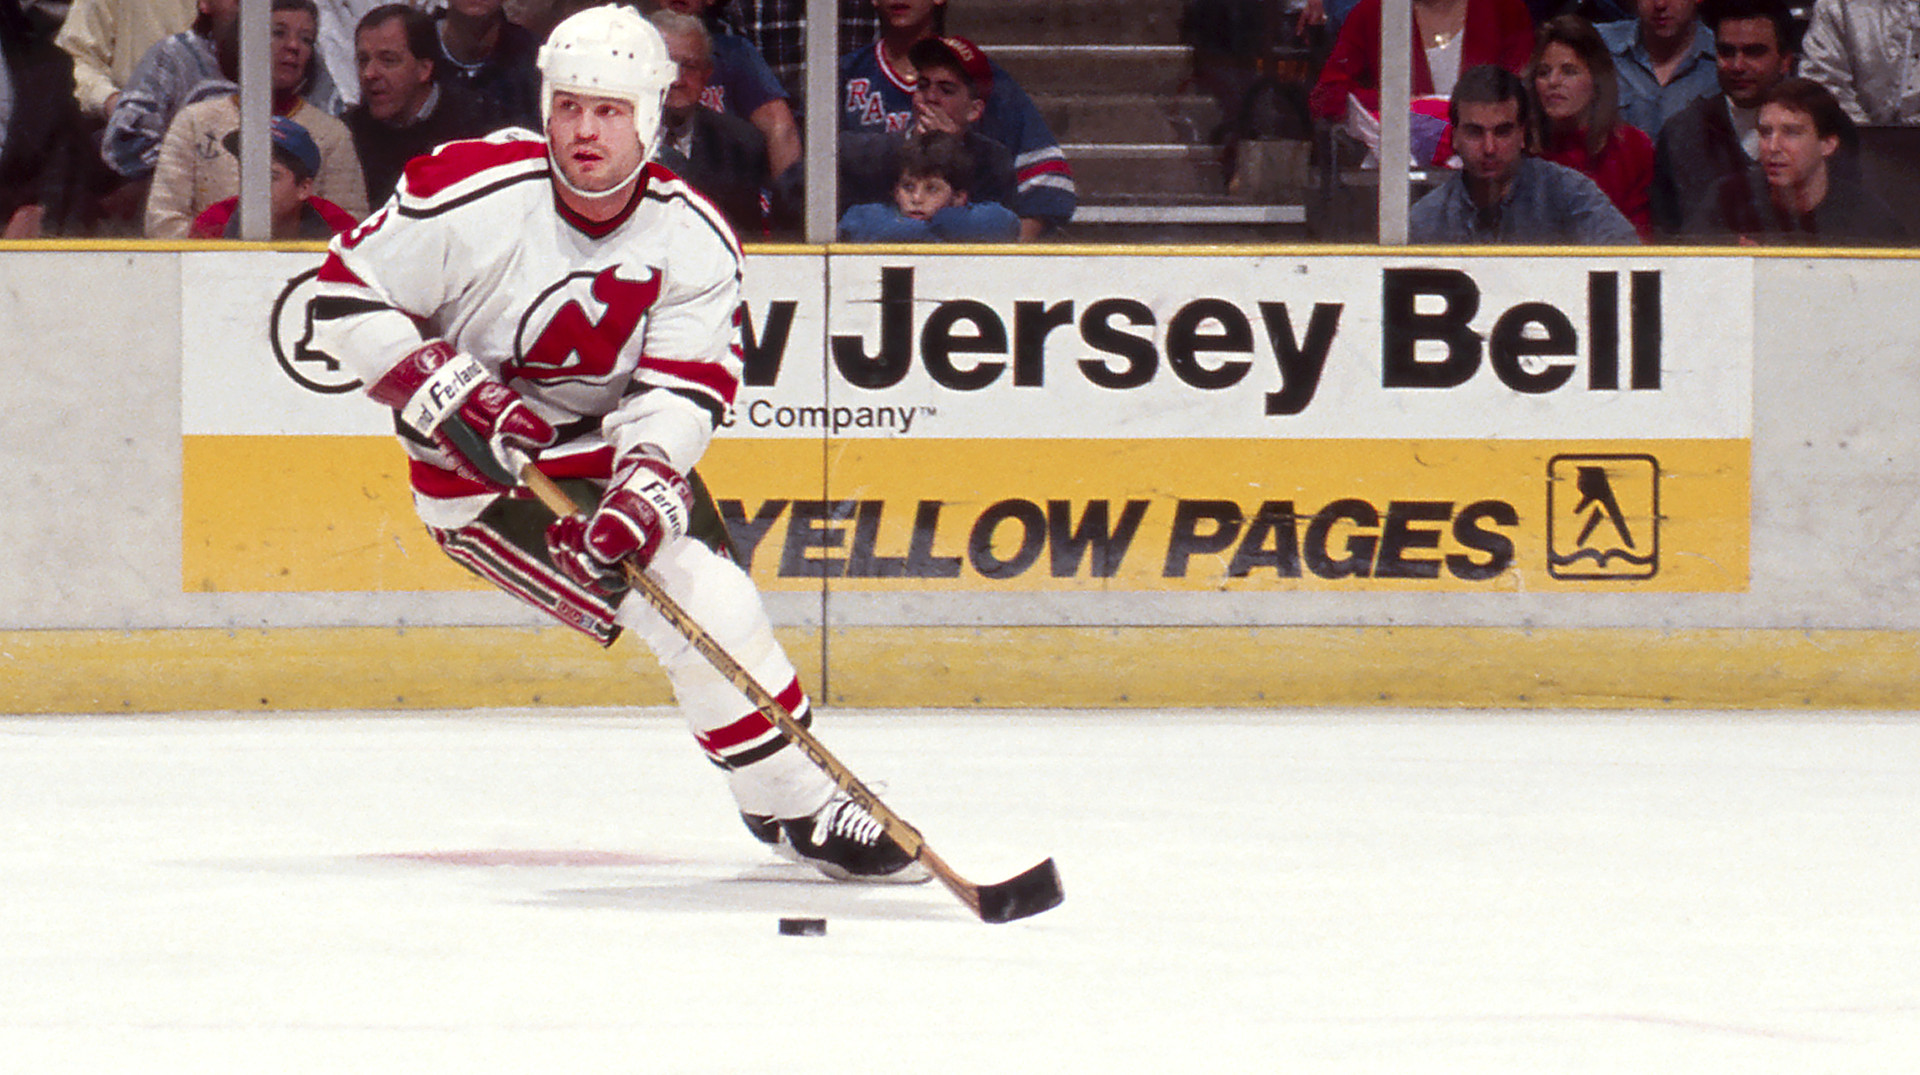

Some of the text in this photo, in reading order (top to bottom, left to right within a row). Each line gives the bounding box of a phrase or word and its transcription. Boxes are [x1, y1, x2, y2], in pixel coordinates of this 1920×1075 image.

[831, 267, 1343, 415] Jersey
[1382, 268, 1662, 394] Bell
[715, 498, 1519, 580] YELLOW PAGES
